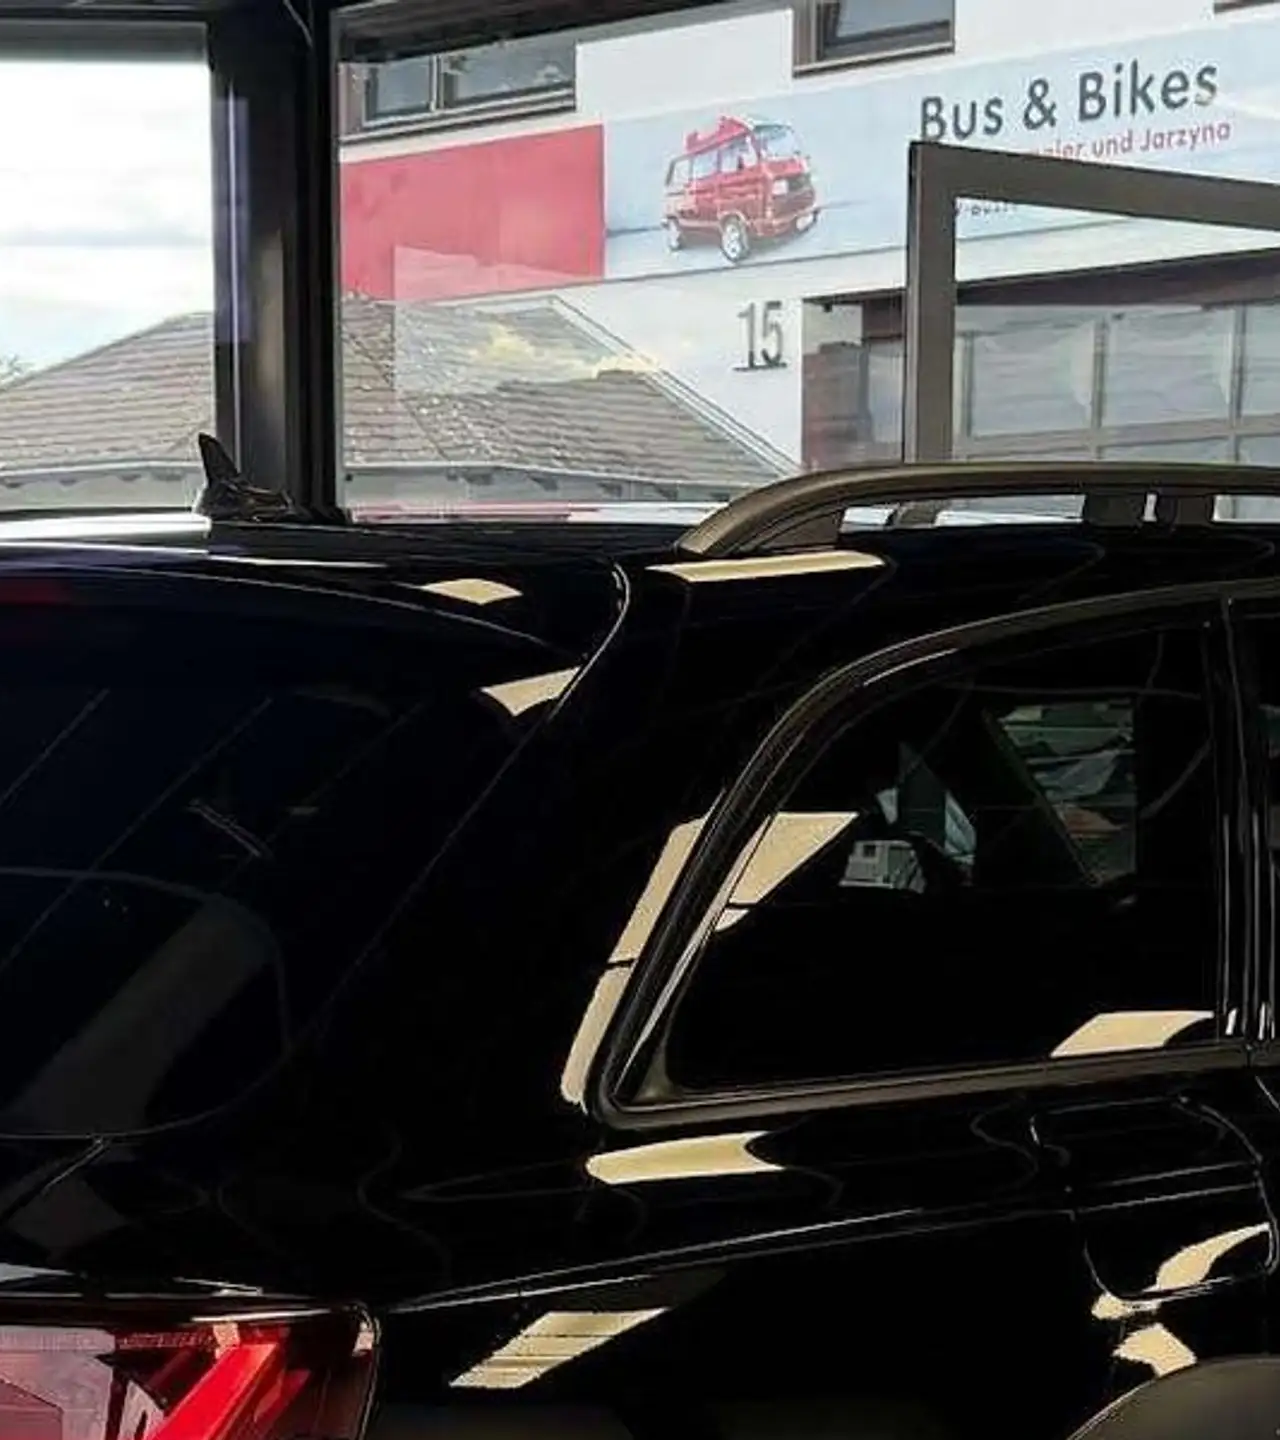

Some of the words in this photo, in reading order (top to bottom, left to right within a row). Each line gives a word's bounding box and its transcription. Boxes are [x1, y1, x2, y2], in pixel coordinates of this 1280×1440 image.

[921, 95, 1004, 141] Bus
[1023, 78, 1057, 131] &
[1078, 58, 1218, 122] Bikes
[1092, 128, 1134, 157] und
[1140, 121, 1231, 152] Jarzyna
[735, 300, 784, 370] 15
